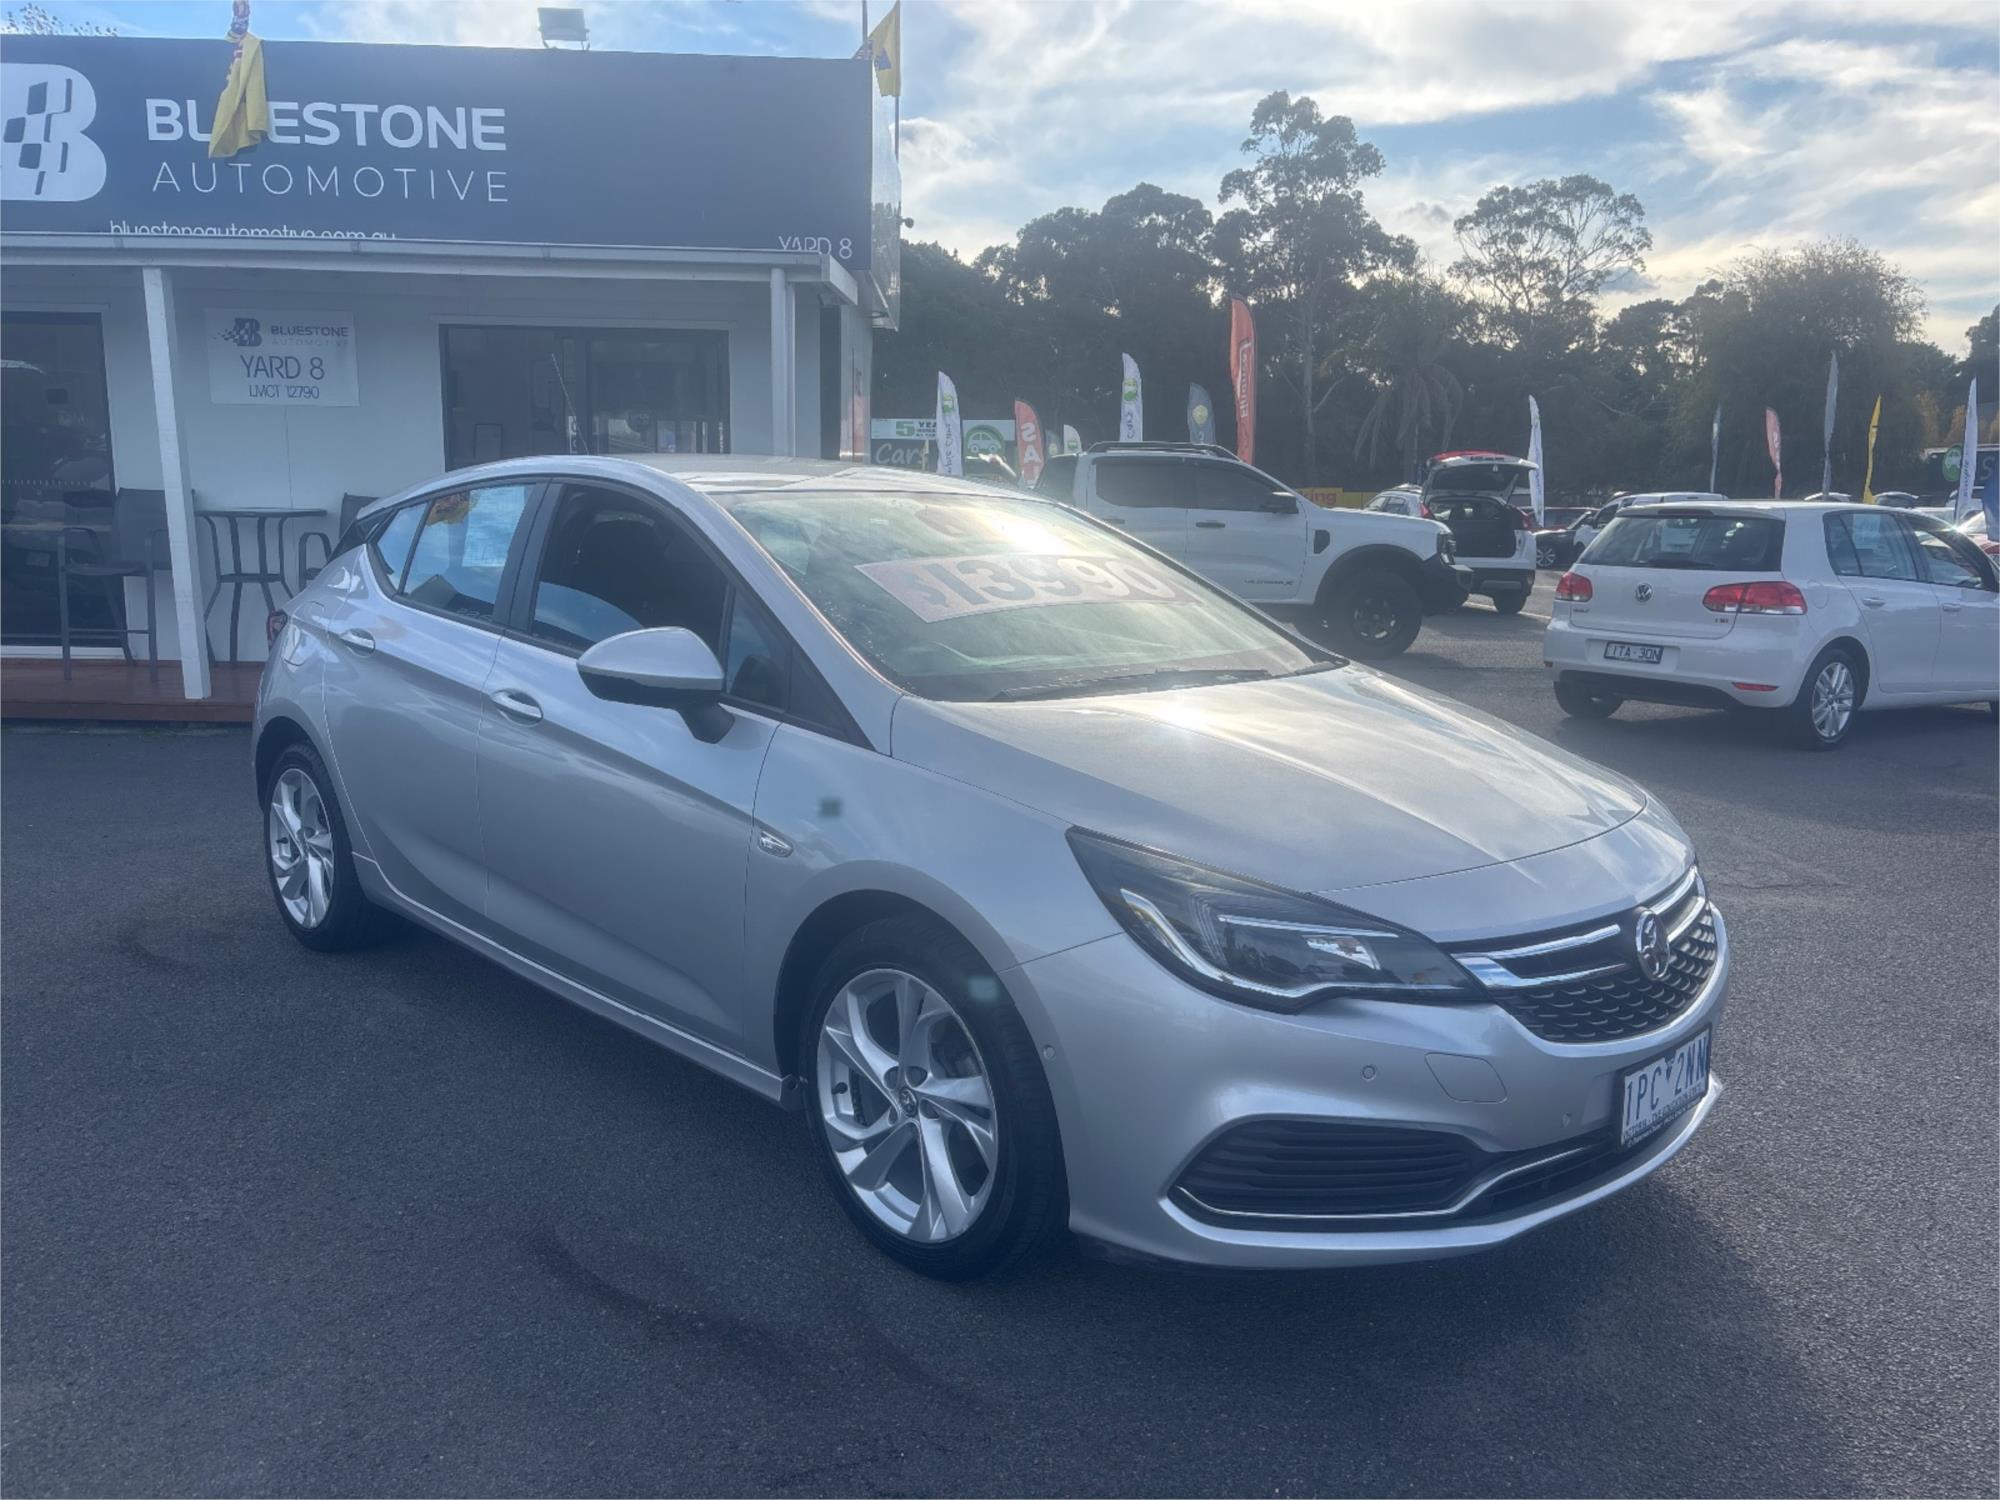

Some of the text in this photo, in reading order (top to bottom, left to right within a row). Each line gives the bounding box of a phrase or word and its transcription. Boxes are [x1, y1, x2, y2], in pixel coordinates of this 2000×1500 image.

[146, 98, 507, 150] BLESTONE
[152, 161, 508, 202] AUTOMOTIVE
[839, 237, 852, 260] 8
[271, 325, 349, 337] BLUESTONE
[240, 354, 325, 381] YARD 8
[249, 384, 321, 400] LMCT 12790
[895, 420, 915, 437] 5
